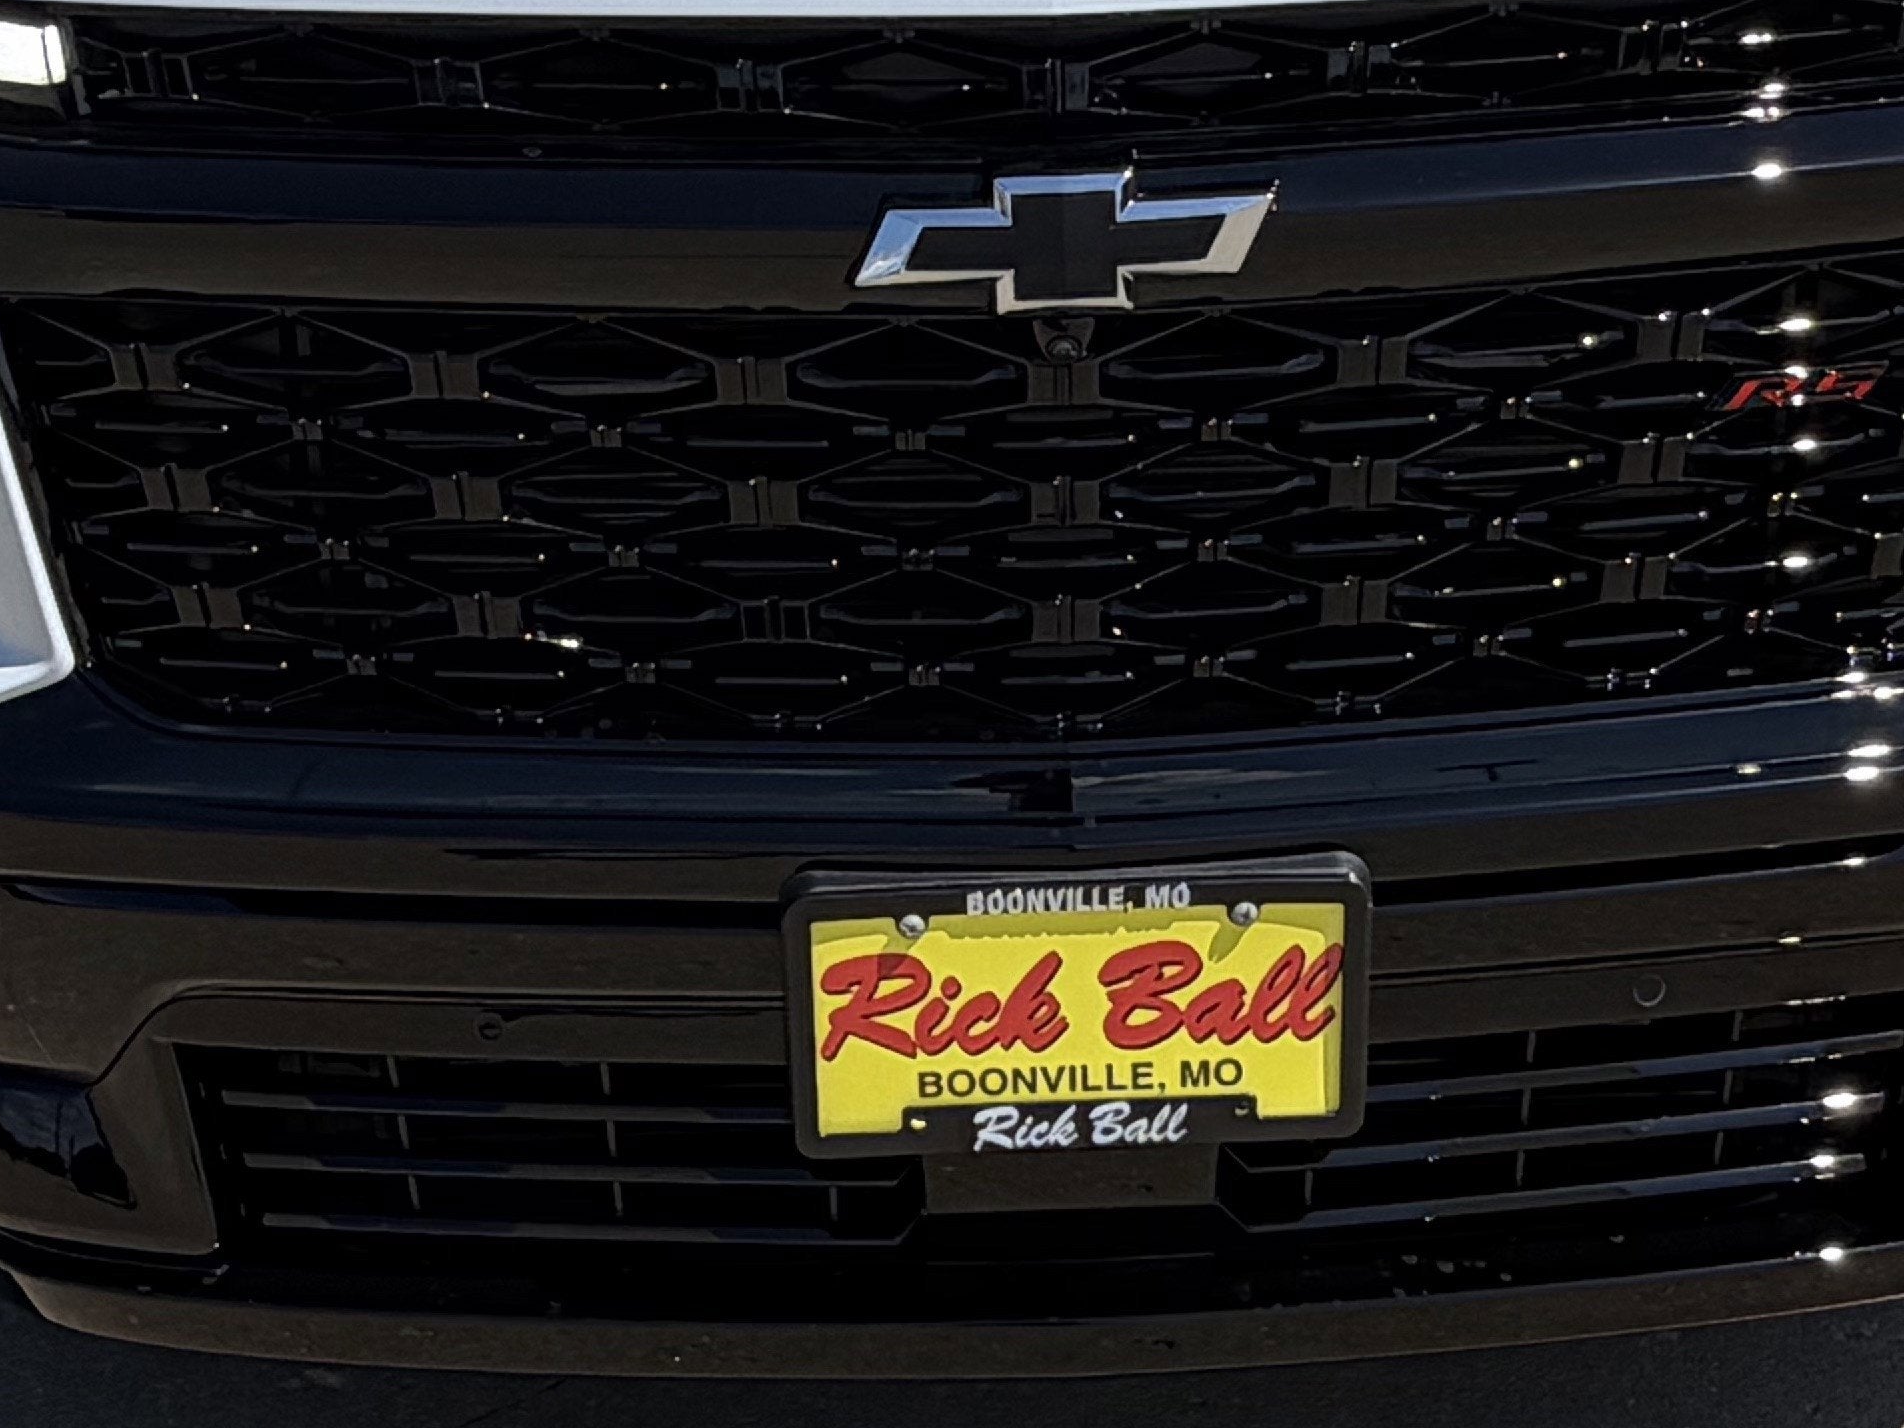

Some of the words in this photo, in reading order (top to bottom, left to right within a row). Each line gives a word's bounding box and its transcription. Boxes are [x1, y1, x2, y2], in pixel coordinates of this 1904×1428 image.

[1722, 360, 1889, 412] RS
[966, 887, 1133, 916] BOONVILLE,
[1145, 882, 1191, 909] MO
[821, 951, 1069, 1061] Rick
[1097, 939, 1343, 1050] Ball
[918, 1062, 1167, 1098] BOONVILLE,
[1180, 1058, 1244, 1088] MO
[973, 1103, 1079, 1152] Rick
[1090, 1102, 1188, 1146] Ball
